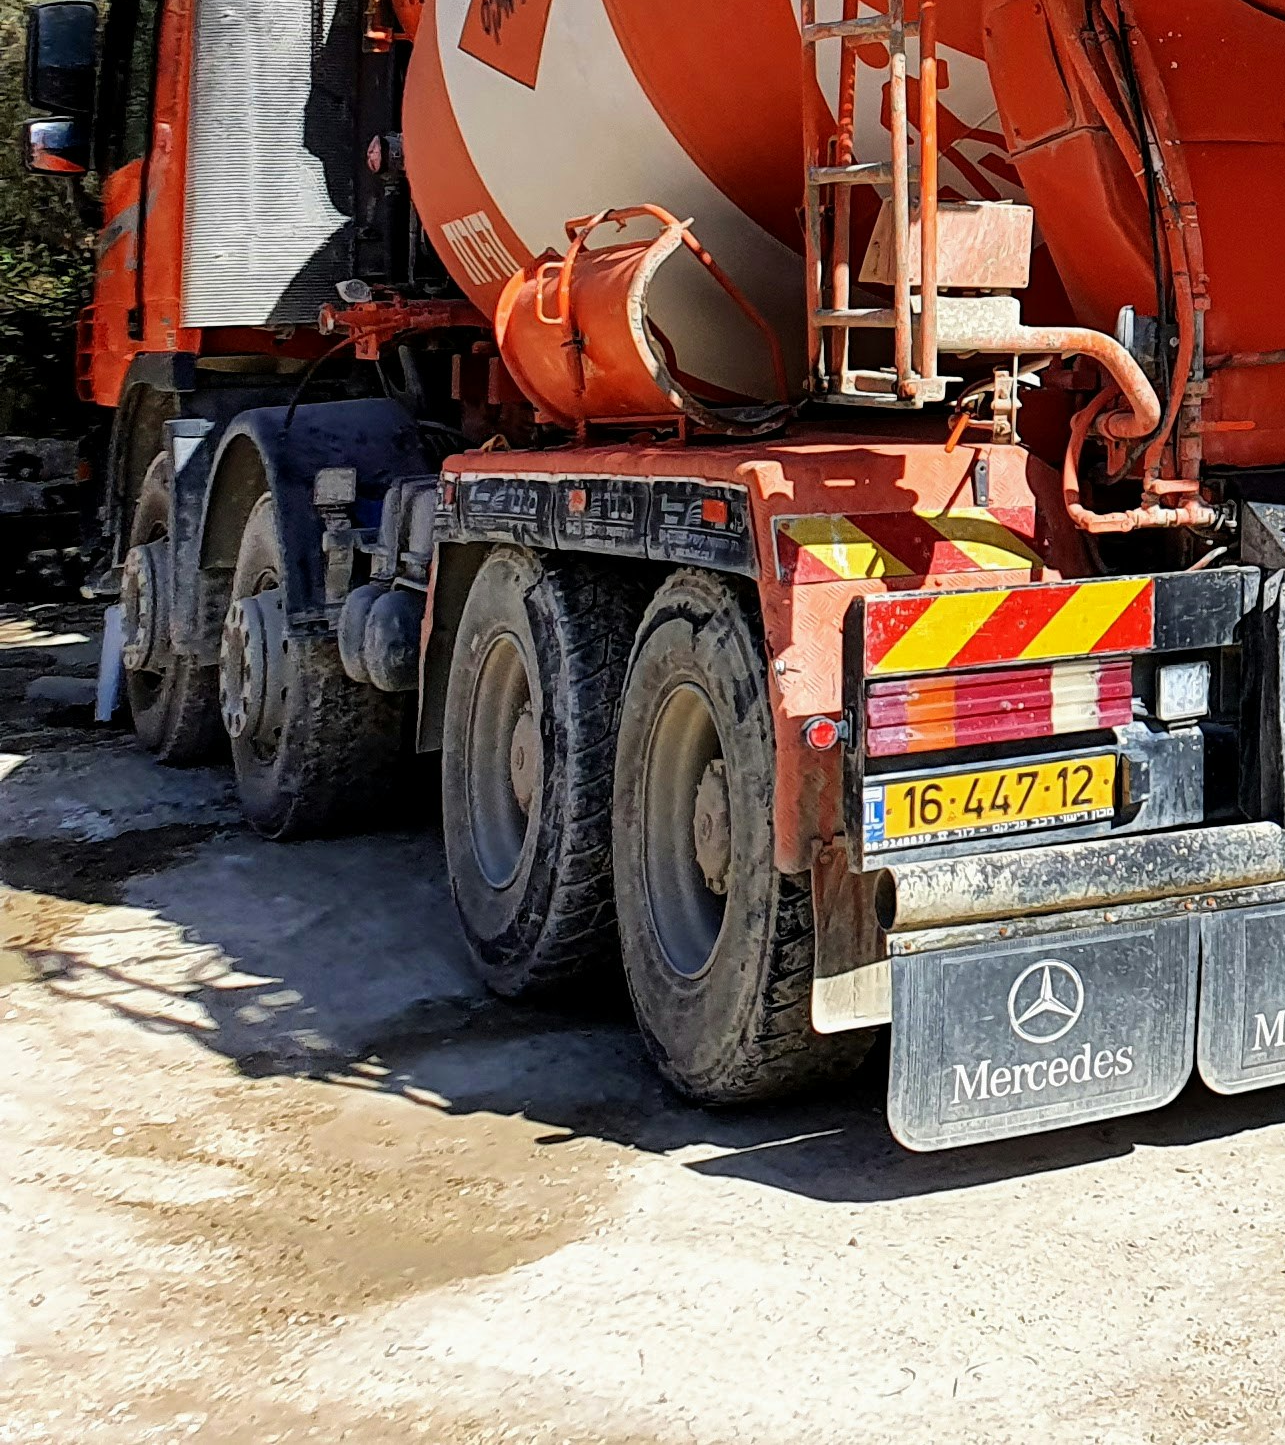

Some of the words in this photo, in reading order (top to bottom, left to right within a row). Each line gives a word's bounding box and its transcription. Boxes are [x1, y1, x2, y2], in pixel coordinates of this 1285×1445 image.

[866, 802, 879, 824] IL
[1060, 811, 1088, 823] רישוי
[1092, 807, 1115, 821] מכון
[1031, 816, 1056, 827] רכב
[950, 1043, 1135, 1105] Mercedes
